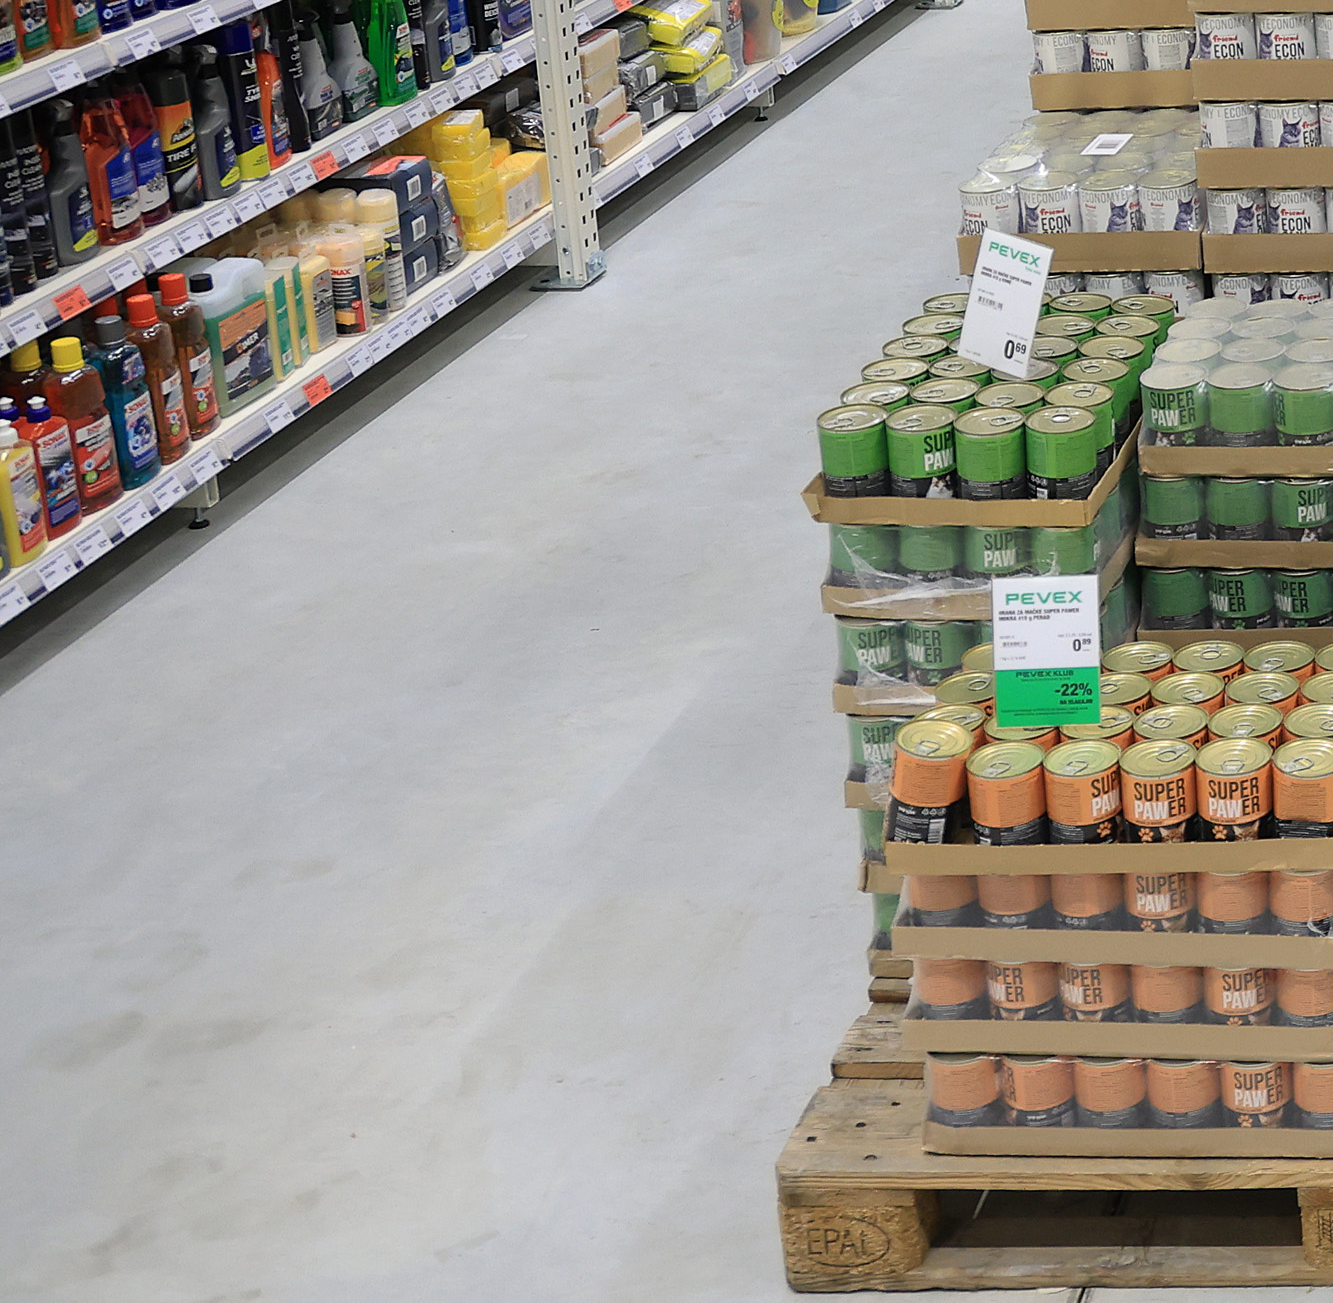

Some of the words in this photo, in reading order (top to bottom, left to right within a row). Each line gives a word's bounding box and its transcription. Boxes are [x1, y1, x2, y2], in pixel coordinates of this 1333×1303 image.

[167, 148, 189, 162] TIRE
[989, 241, 1041, 267] PEVEX
[1004, 340, 1015, 359] 0
[1016, 343, 1026, 355] 69
[1150, 390, 1194, 410] SUPER
[1151, 408, 1196, 427] PAWER
[1005, 591, 1083, 605] PEVEX
[1073, 639, 1081, 652] 0
[1054, 682, 1092, 697] -22%
[1133, 779, 1185, 803] SUPER
[1133, 798, 1185, 821] PAWER
[808, 1227, 875, 1258] EPAL
